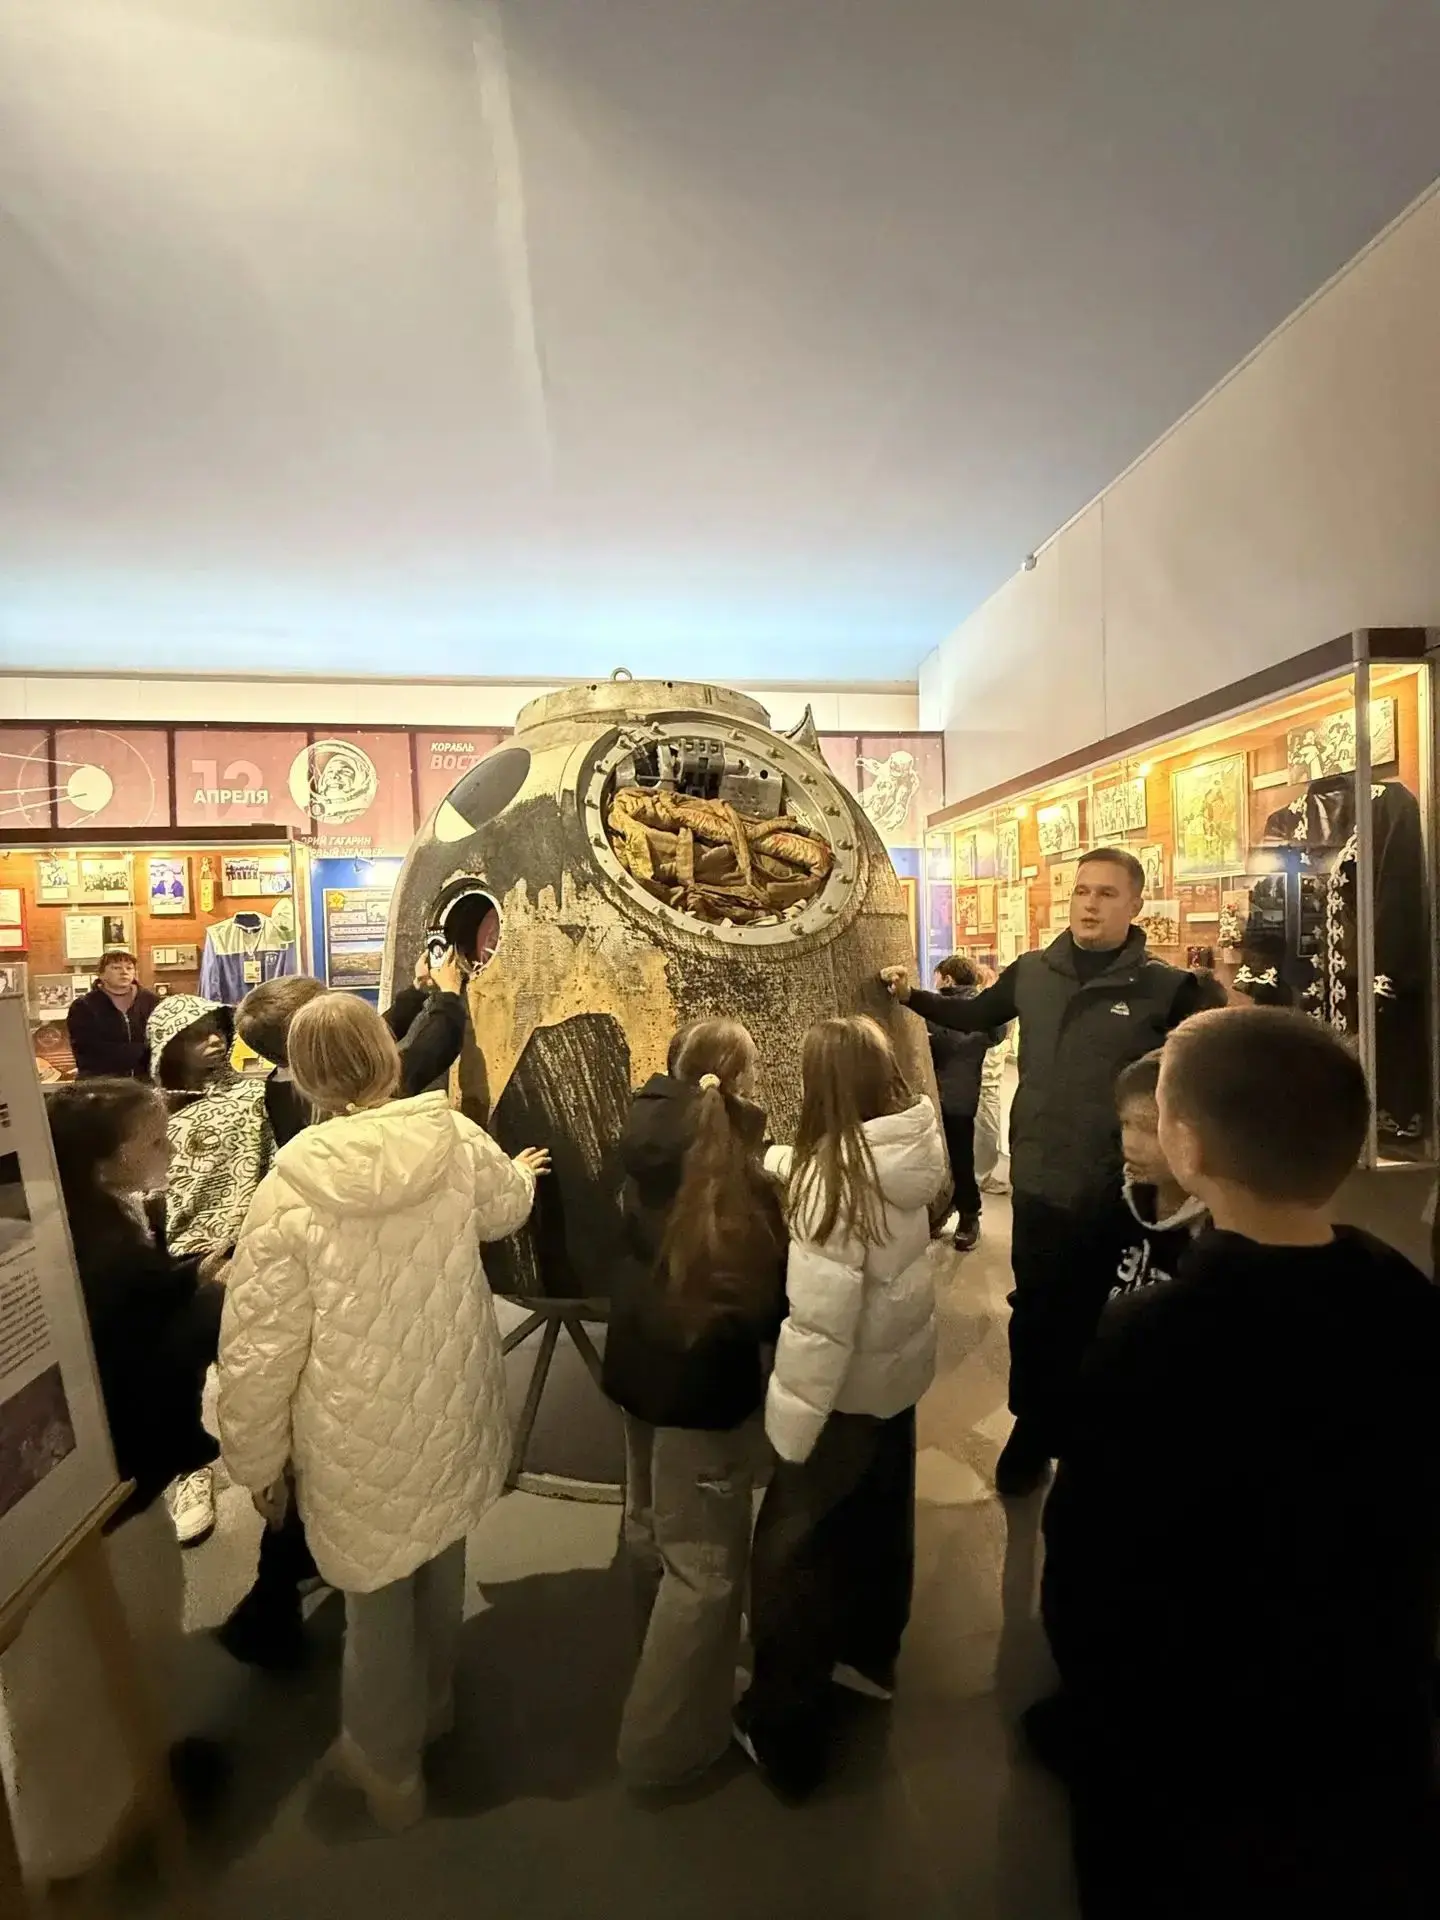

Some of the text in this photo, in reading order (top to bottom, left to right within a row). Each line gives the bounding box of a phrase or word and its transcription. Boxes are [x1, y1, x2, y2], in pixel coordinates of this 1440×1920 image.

[430, 742, 475, 752] КОРАБЛЬ
[430, 754, 481, 769] ВОСТ
[192, 759, 263, 820] 12
[193, 789, 269, 804] АПРЕЛЯ
[328, 836, 372, 846] ГАГАРИН
[310, 847, 340, 857] РВЫЙ
